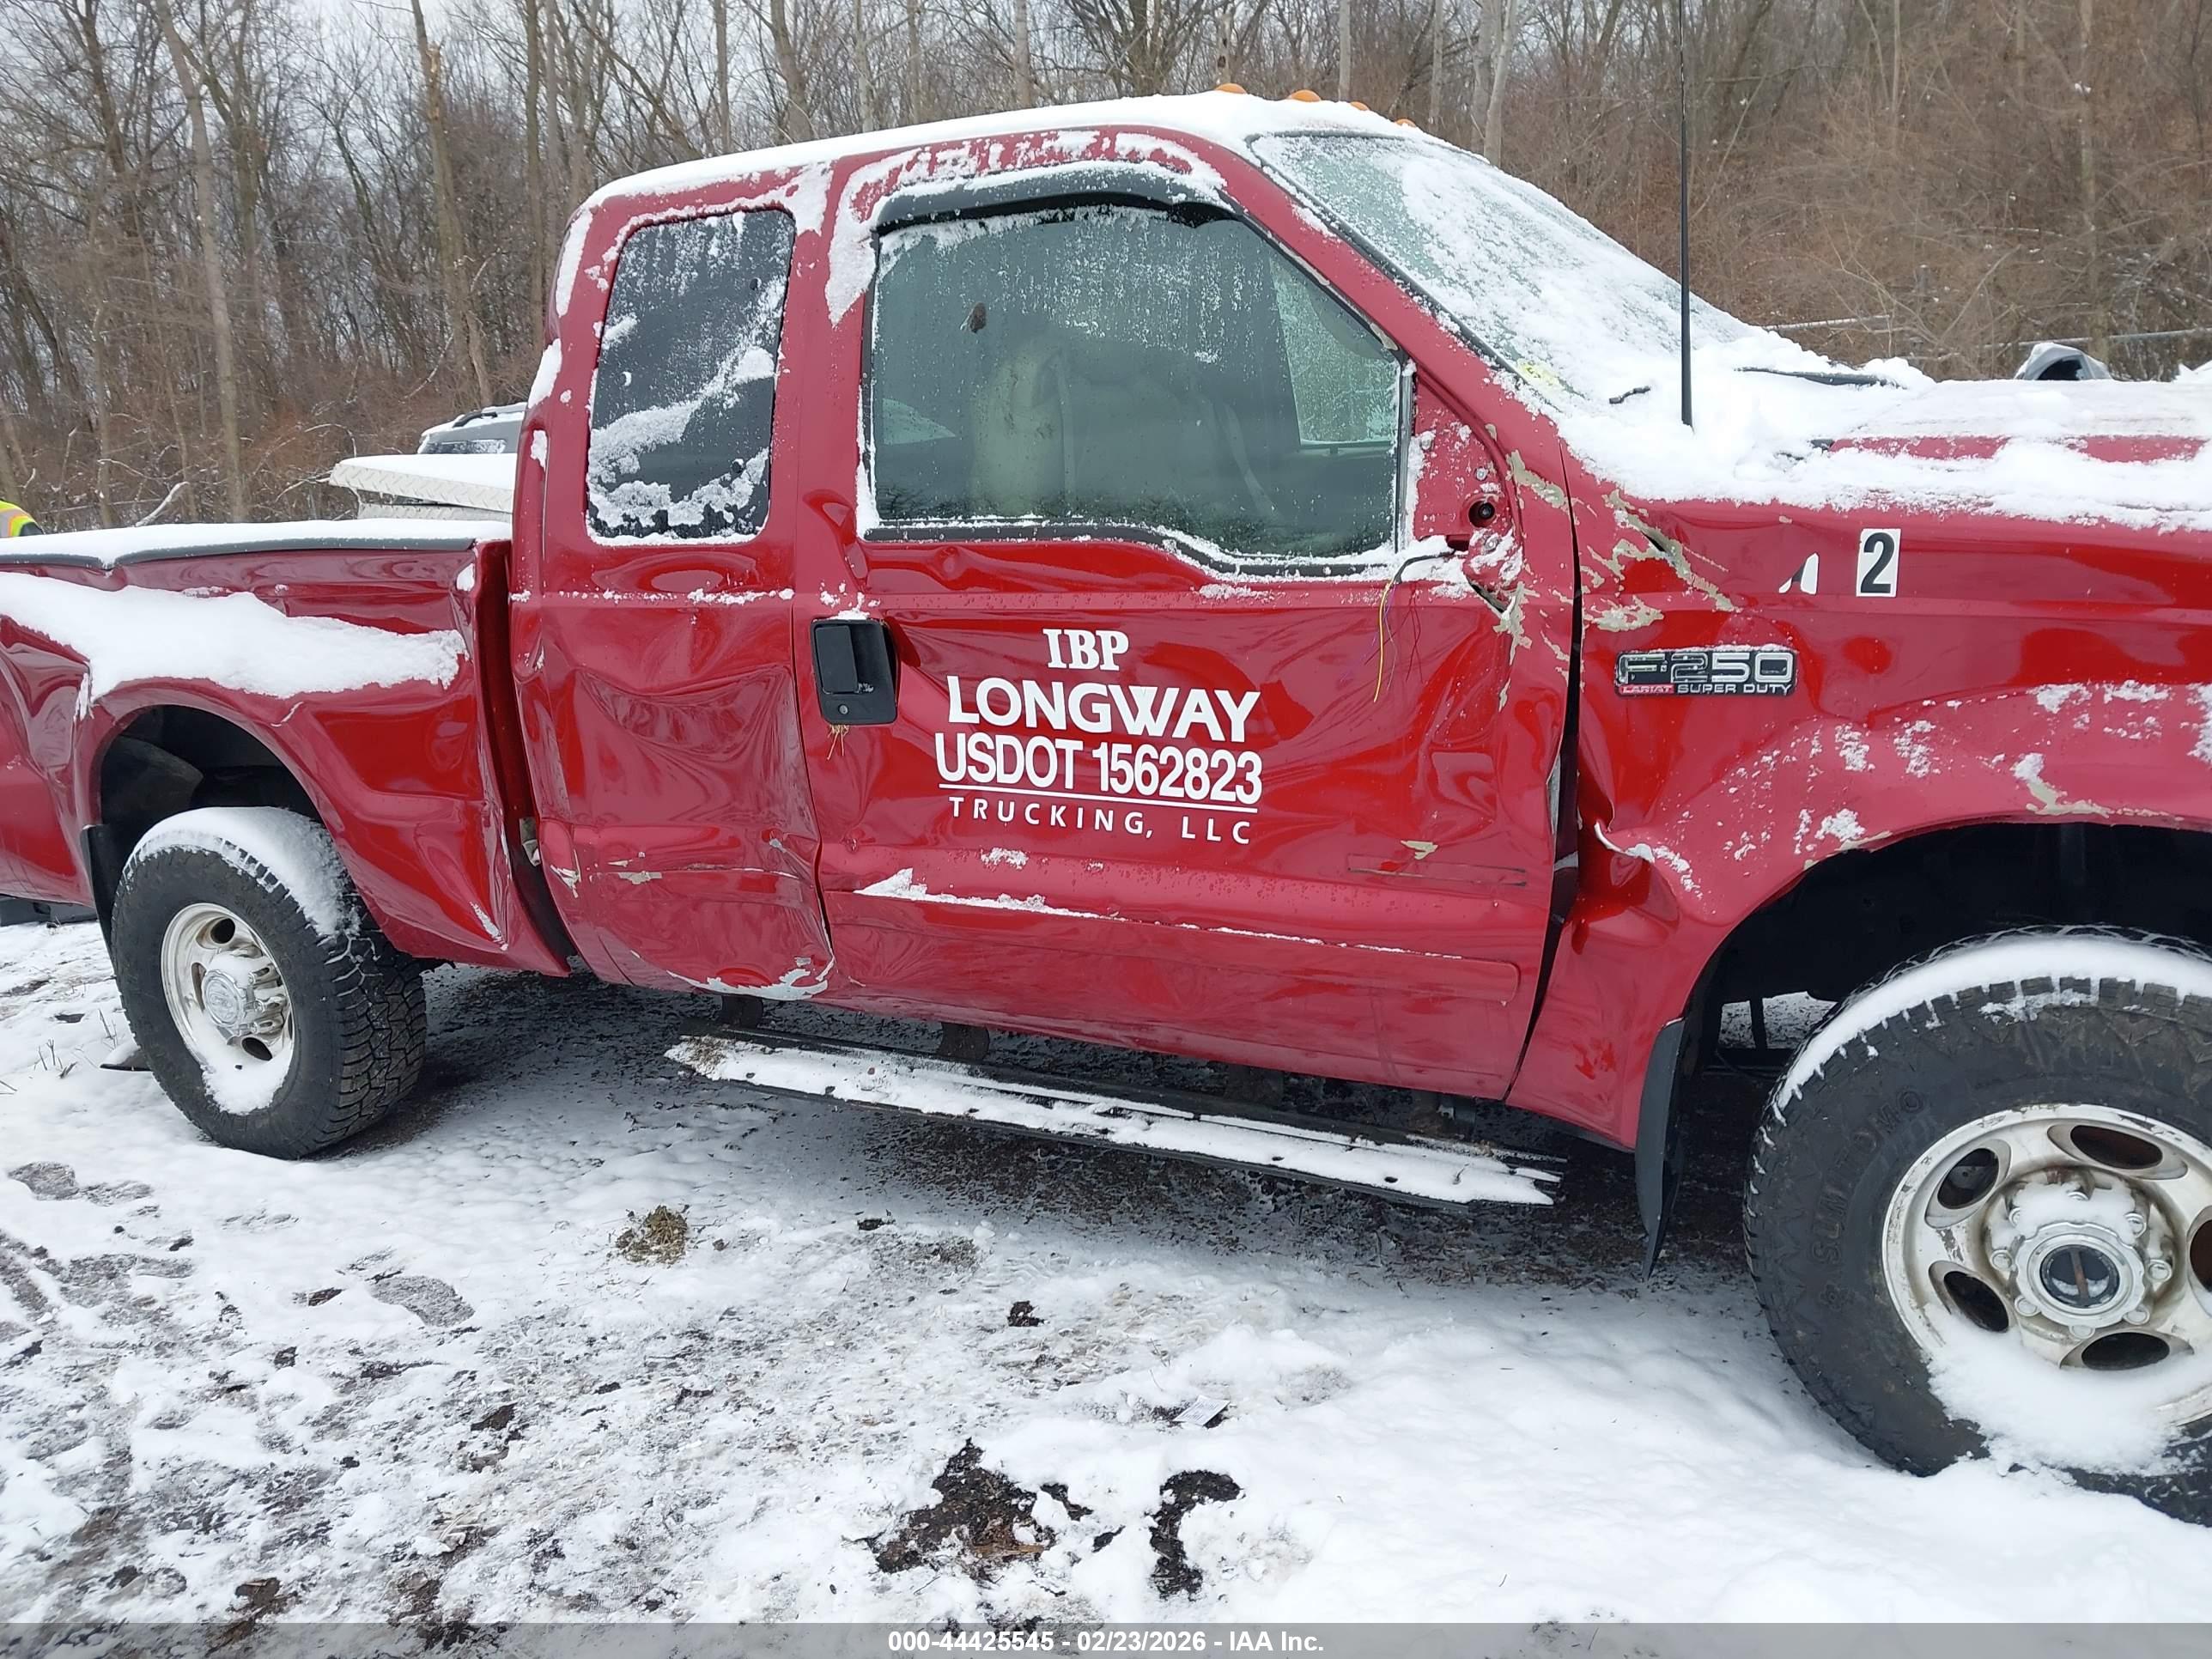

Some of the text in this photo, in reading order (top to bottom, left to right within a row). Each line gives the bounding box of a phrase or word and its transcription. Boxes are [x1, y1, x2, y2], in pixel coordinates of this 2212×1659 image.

[1860, 532, 1895, 594] 2
[1042, 628, 1129, 671] IBP
[946, 675, 1261, 744] LONGWAY
[1621, 684, 1791, 694] LARIAT SUPER DUTY
[934, 732, 1263, 805] USDOT 1562823
[948, 796, 1251, 845] TRUCKING, LLC
[1809, 1090, 1923, 1264] SUMITOMO
